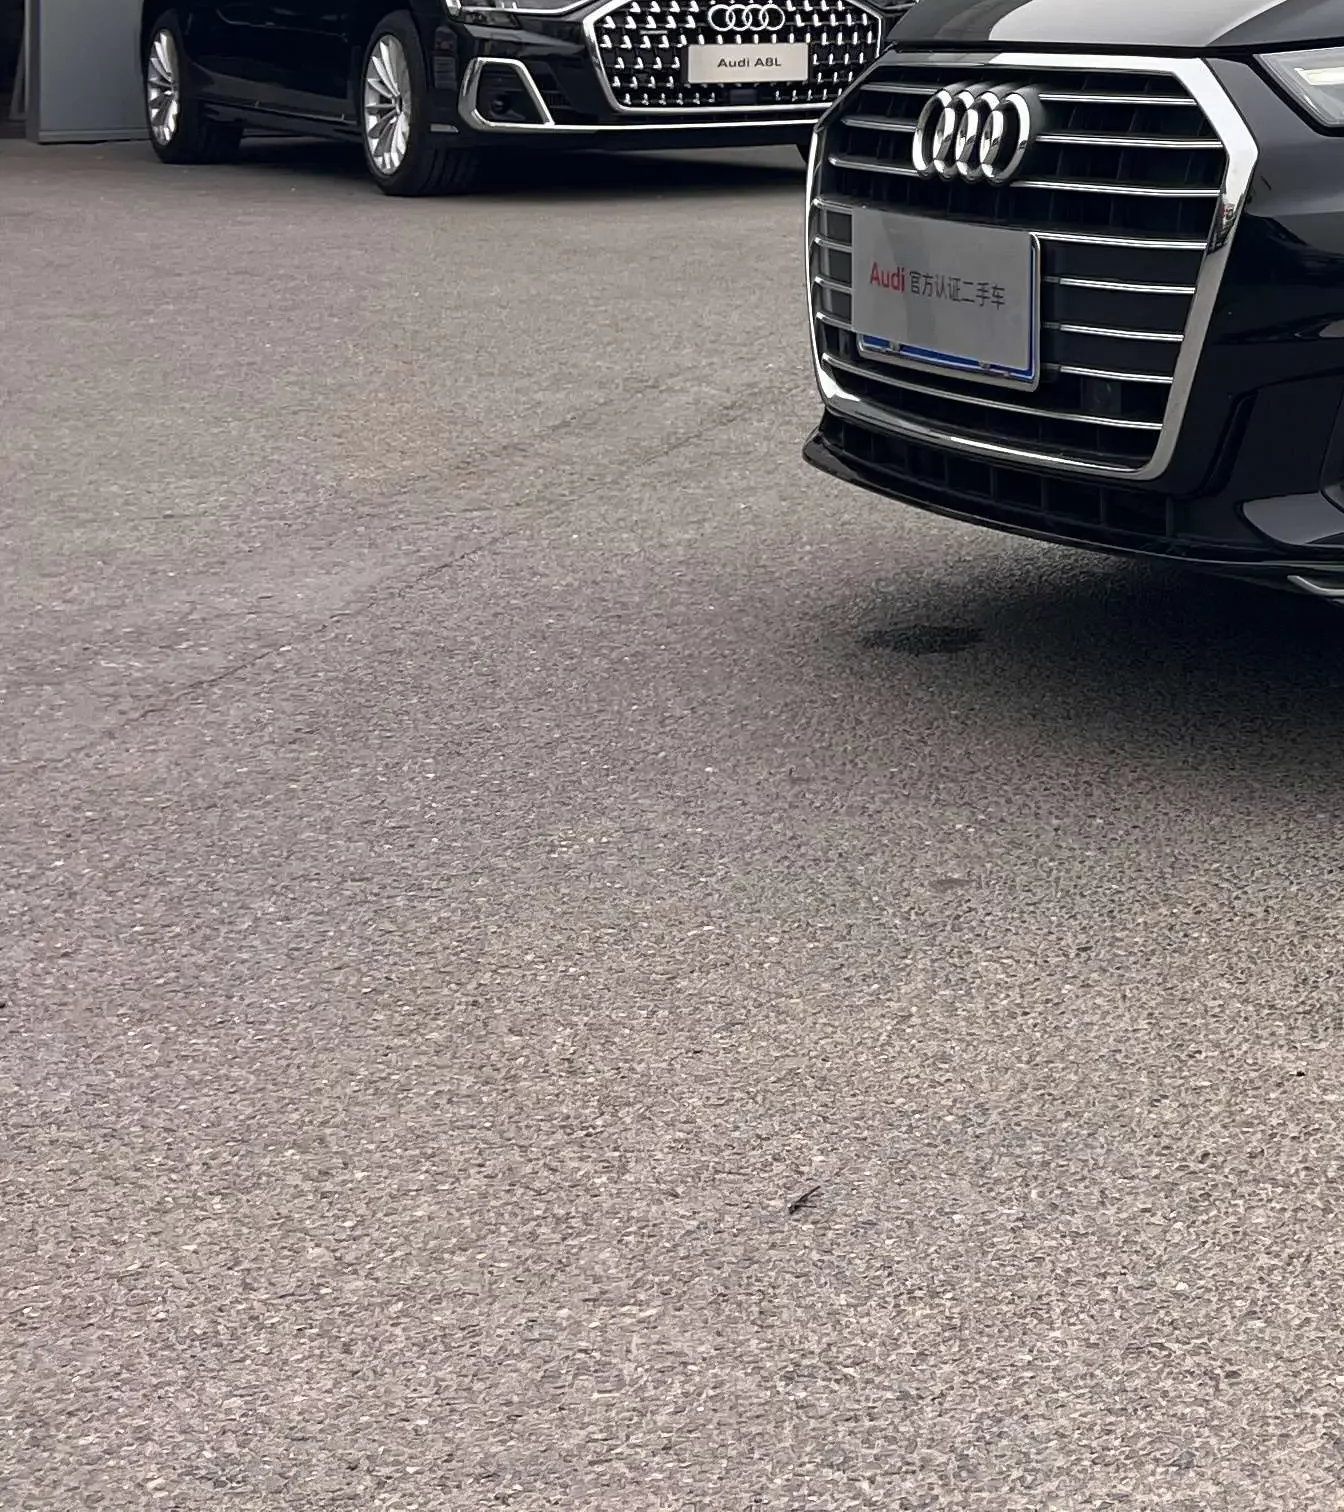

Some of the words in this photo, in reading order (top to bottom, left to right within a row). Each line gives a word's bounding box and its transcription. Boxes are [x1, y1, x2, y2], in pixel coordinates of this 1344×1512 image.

[717, 57, 750, 68] Audi
[754, 57, 782, 67] A8L
[869, 261, 906, 292] Audi
[909, 270, 1006, 311] 官方认证二手车
